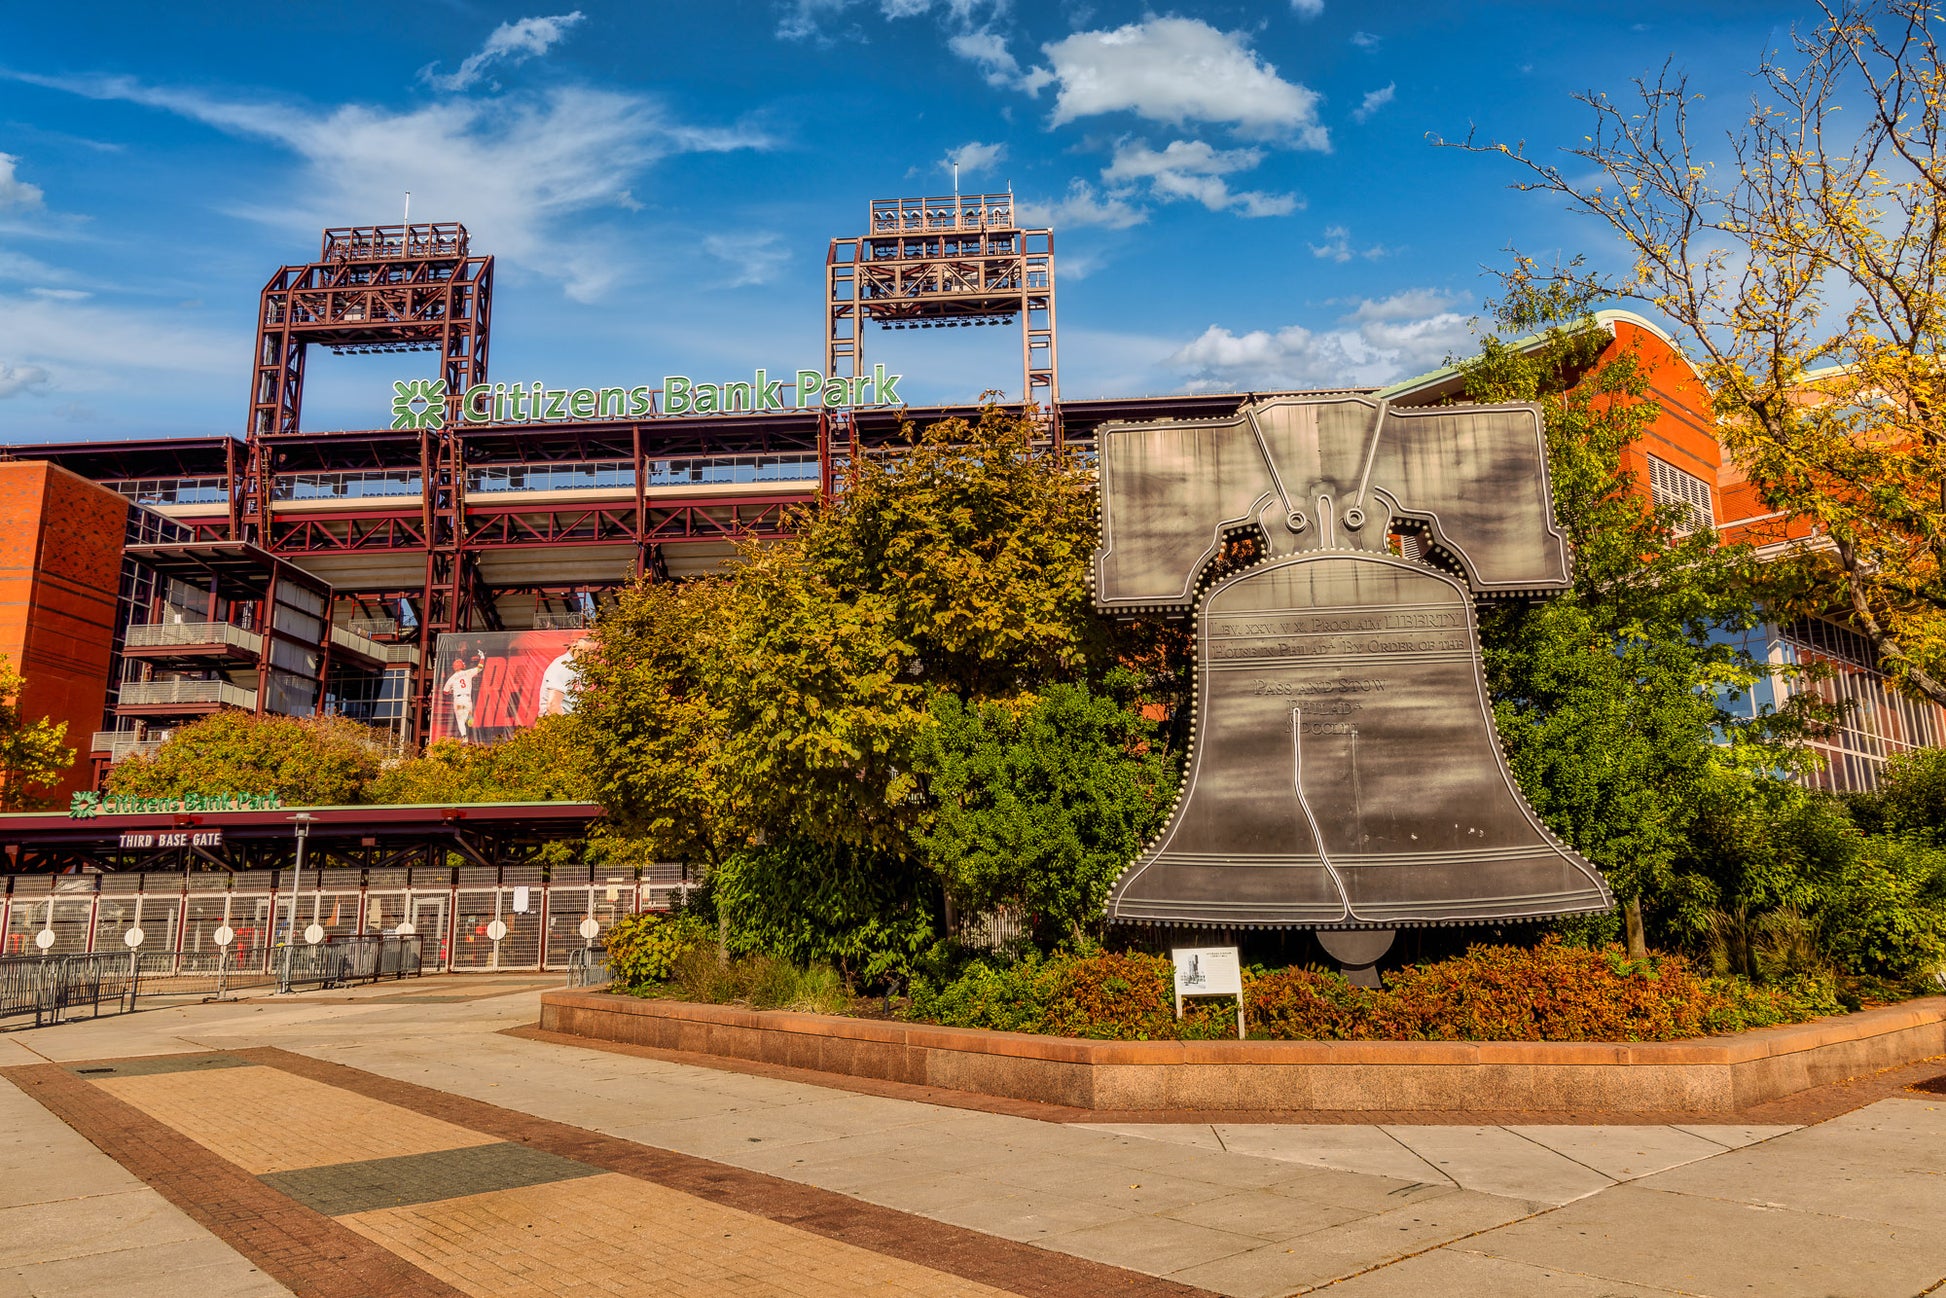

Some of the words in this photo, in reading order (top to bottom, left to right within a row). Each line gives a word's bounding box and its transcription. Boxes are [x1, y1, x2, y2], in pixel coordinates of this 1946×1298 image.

[462, 381, 650, 423] Citizens
[663, 369, 784, 415] Bank
[796, 364, 901, 409] Park
[1384, 613, 1463, 630] LIBERTY
[1212, 645, 1257, 659] HOUSE
[1260, 647, 1276, 658] IN
[1342, 640, 1363, 655] BY
[1367, 639, 1416, 654] ORDER
[1419, 640, 1435, 652] OF
[1439, 639, 1465, 651] THE
[459, 678, 467, 688] 3
[1254, 679, 1292, 696] PASS
[1297, 681, 1336, 696] AND
[1338, 677, 1387, 693] STOW
[102, 794, 180, 813] Citizens
[184, 791, 234, 812] Bank
[237, 789, 281, 811] Park
[119, 834, 153, 848] THIRD
[158, 833, 189, 847] BASE
[192, 832, 223, 846] GATE
